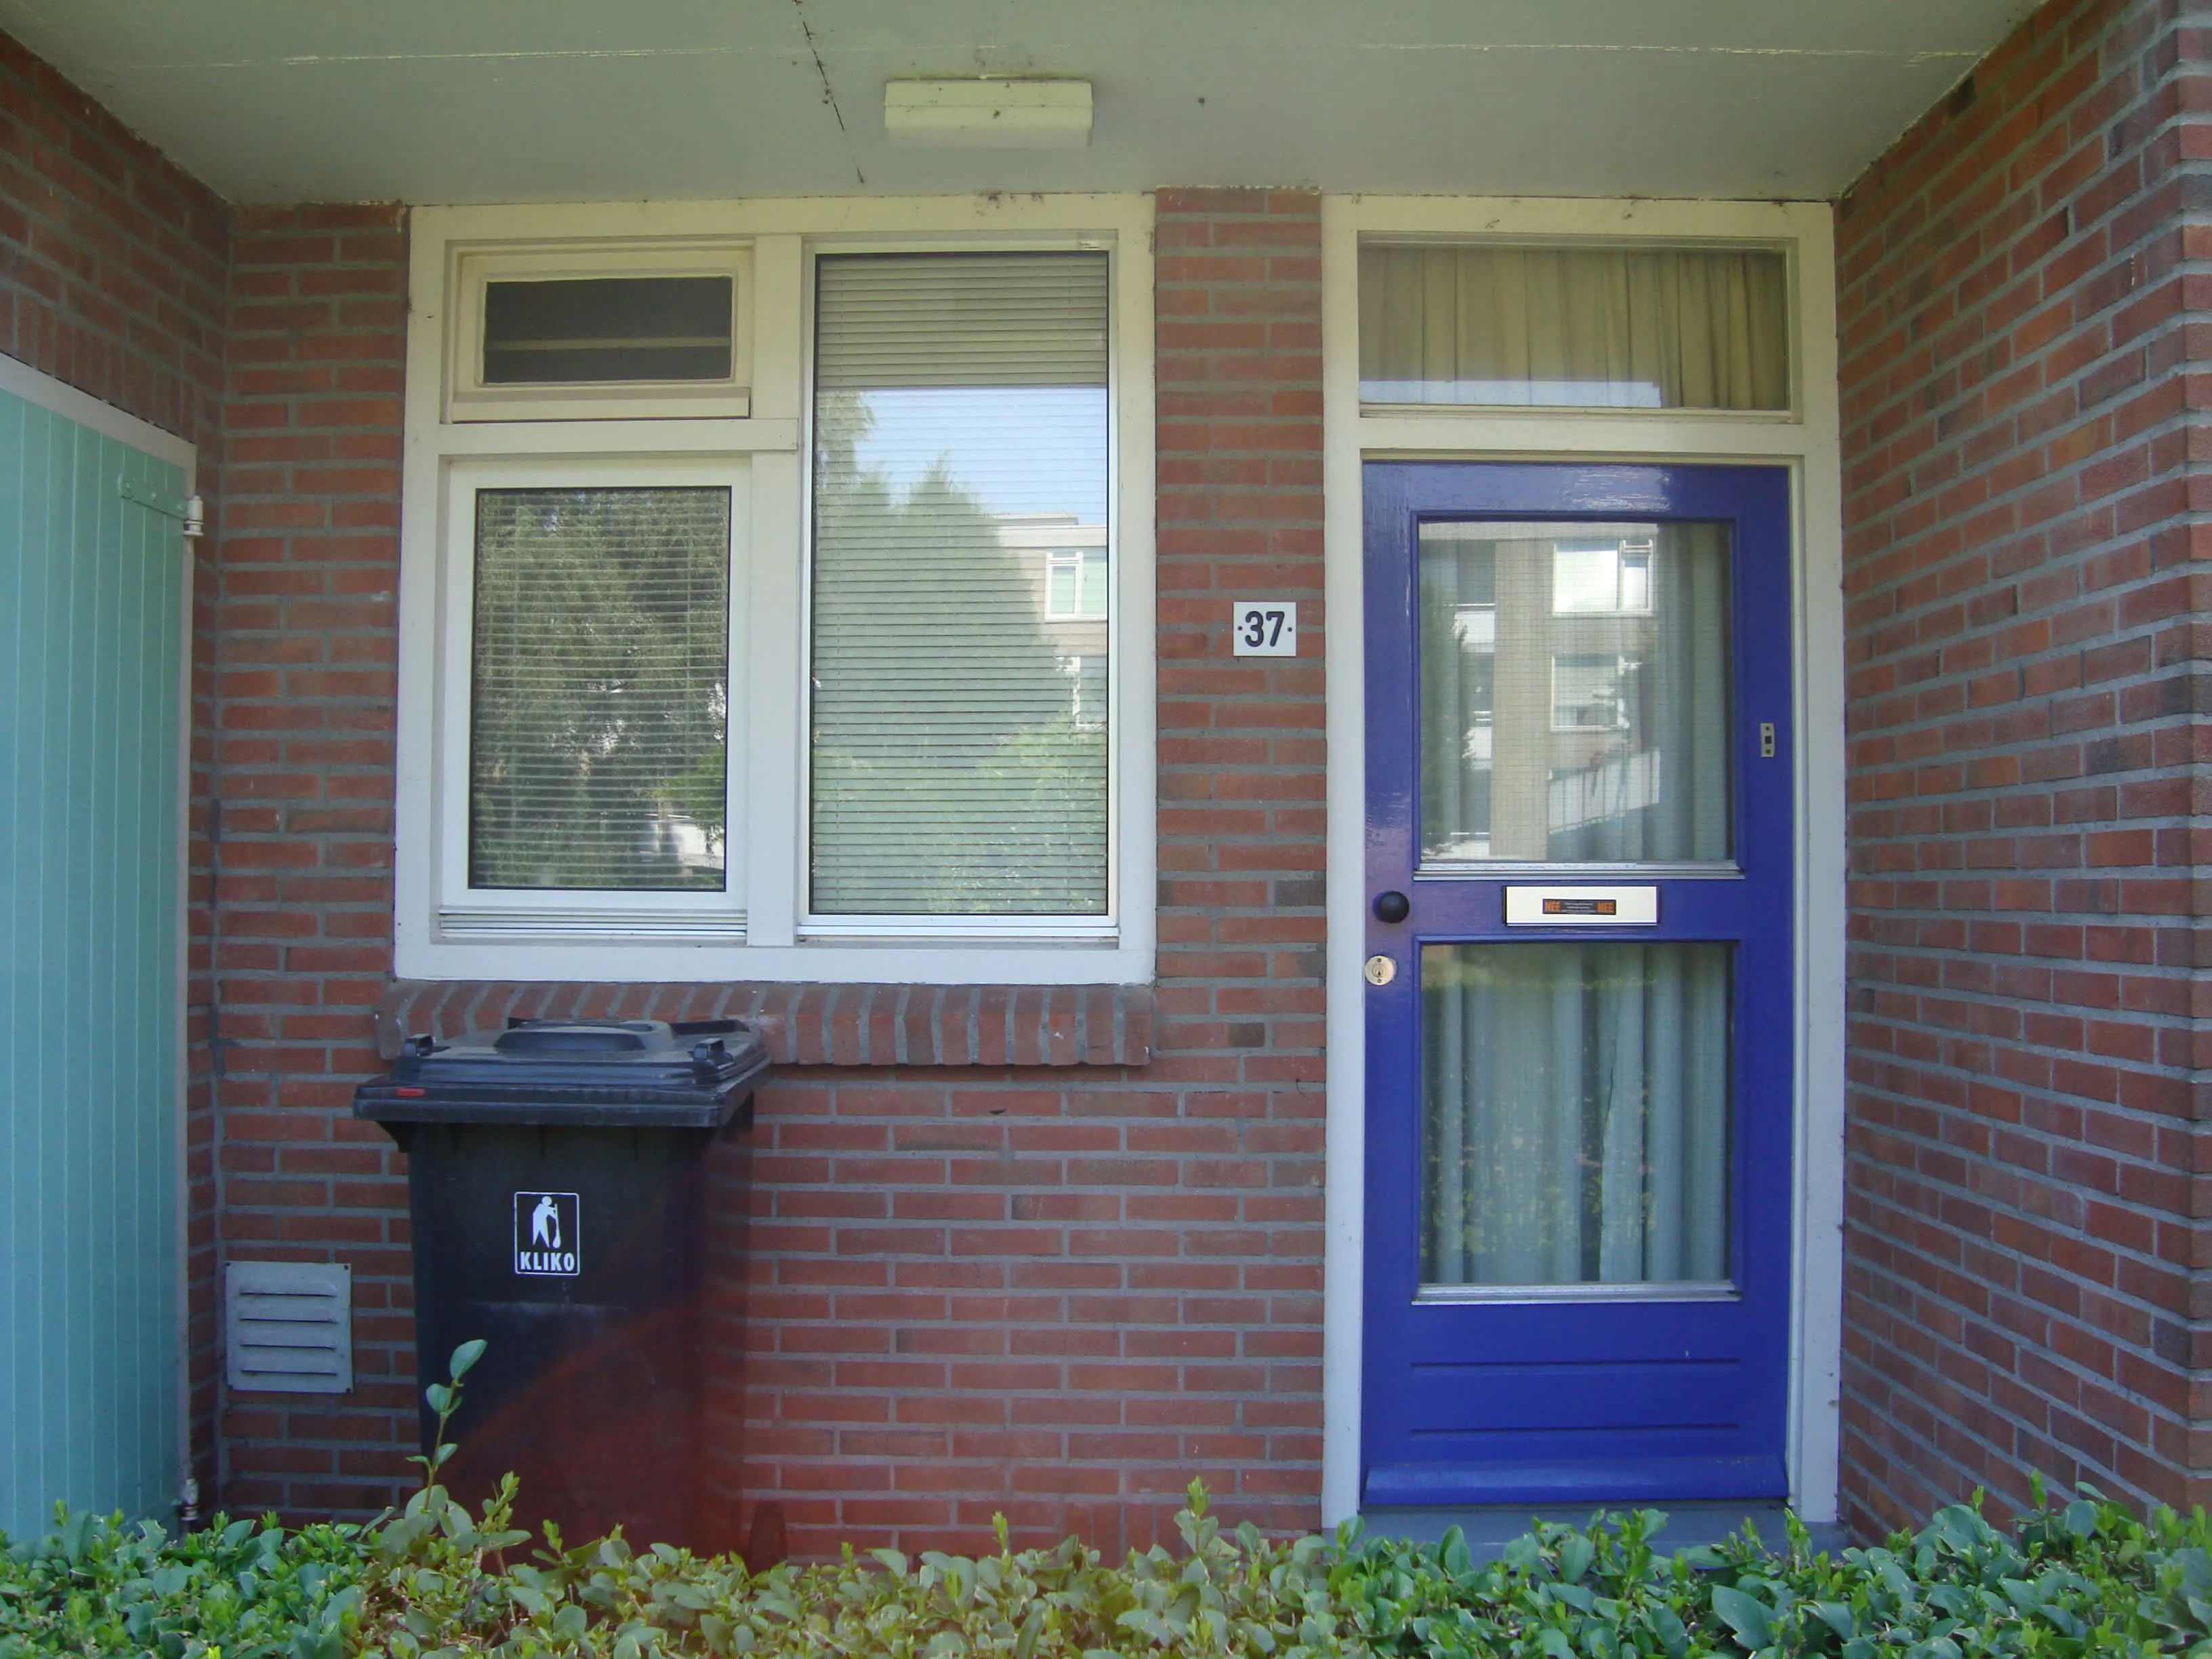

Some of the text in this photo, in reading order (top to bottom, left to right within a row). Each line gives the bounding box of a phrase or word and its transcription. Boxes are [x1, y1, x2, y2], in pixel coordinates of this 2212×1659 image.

[1245, 611, 1284, 647] 37
[1597, 902, 1614, 913] NEE
[520, 1252, 575, 1271] KLIKO
